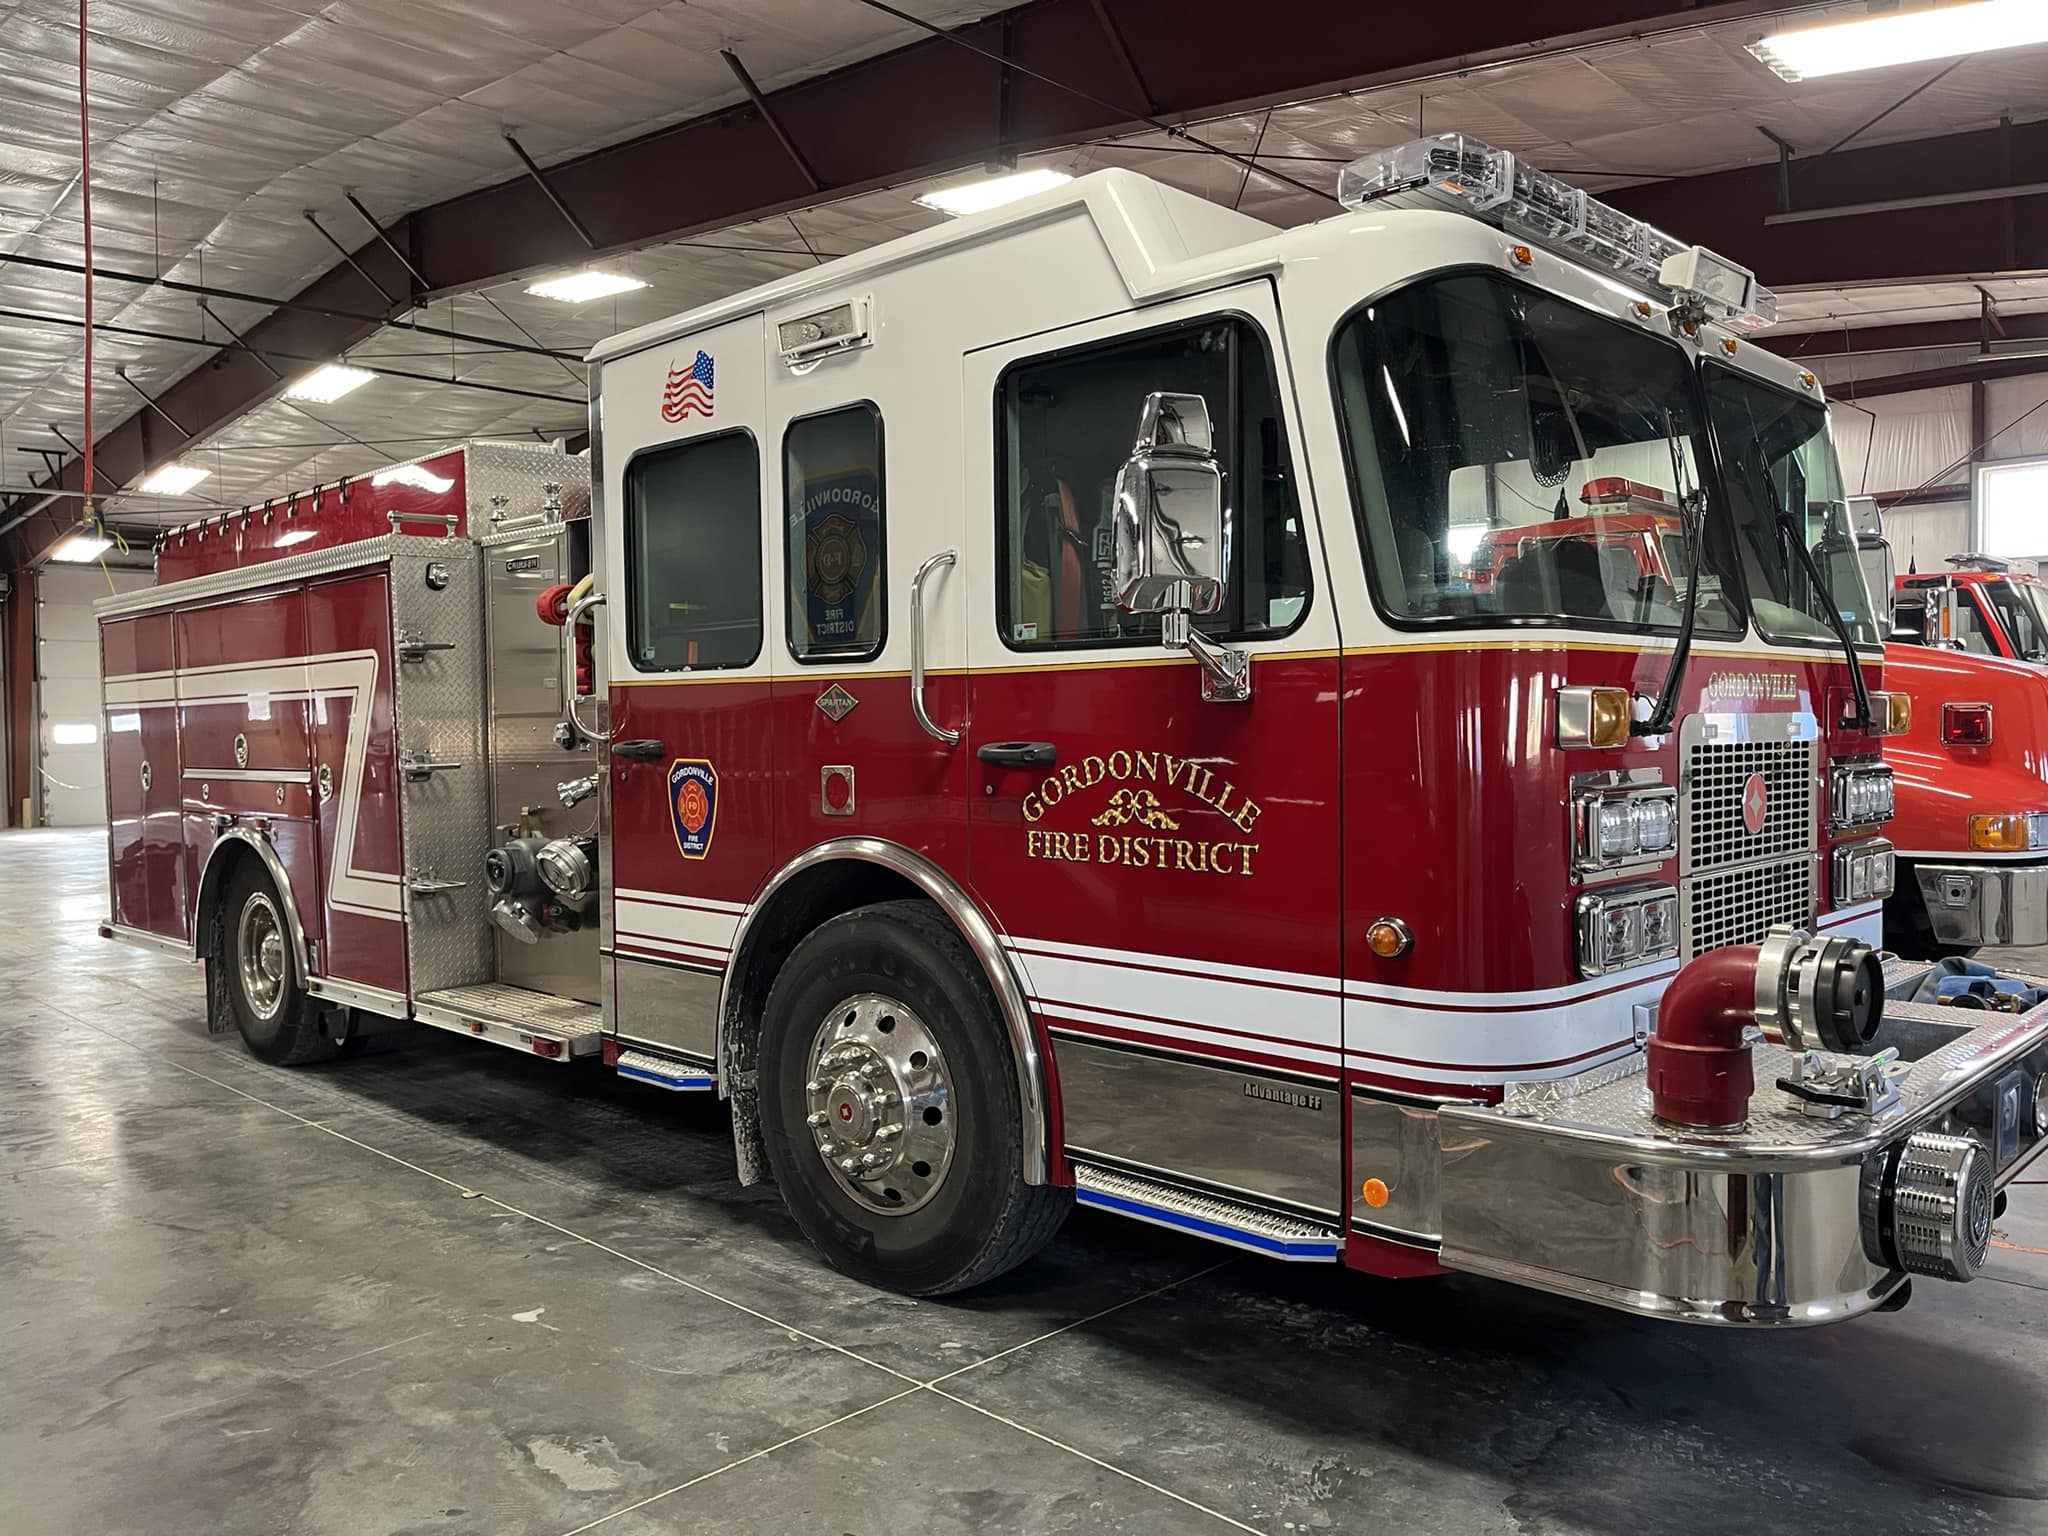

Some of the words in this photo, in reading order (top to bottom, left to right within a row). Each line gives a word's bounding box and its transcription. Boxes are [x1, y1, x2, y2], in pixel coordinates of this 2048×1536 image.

[1708, 672, 1797, 699] GORDONVILLE
[819, 698, 852, 706] SPARTAN
[672, 767, 714, 786] GORDONVILLE
[1021, 750, 1262, 834] GORDONVILLE
[683, 842, 704, 850] DISTRICT
[687, 835, 698, 843] FIRE
[1026, 830, 1090, 862] FIRE
[1097, 835, 1259, 876] DISTRICT
[1244, 1083, 1306, 1106] Advantage
[1308, 1095, 1321, 1110] FF
